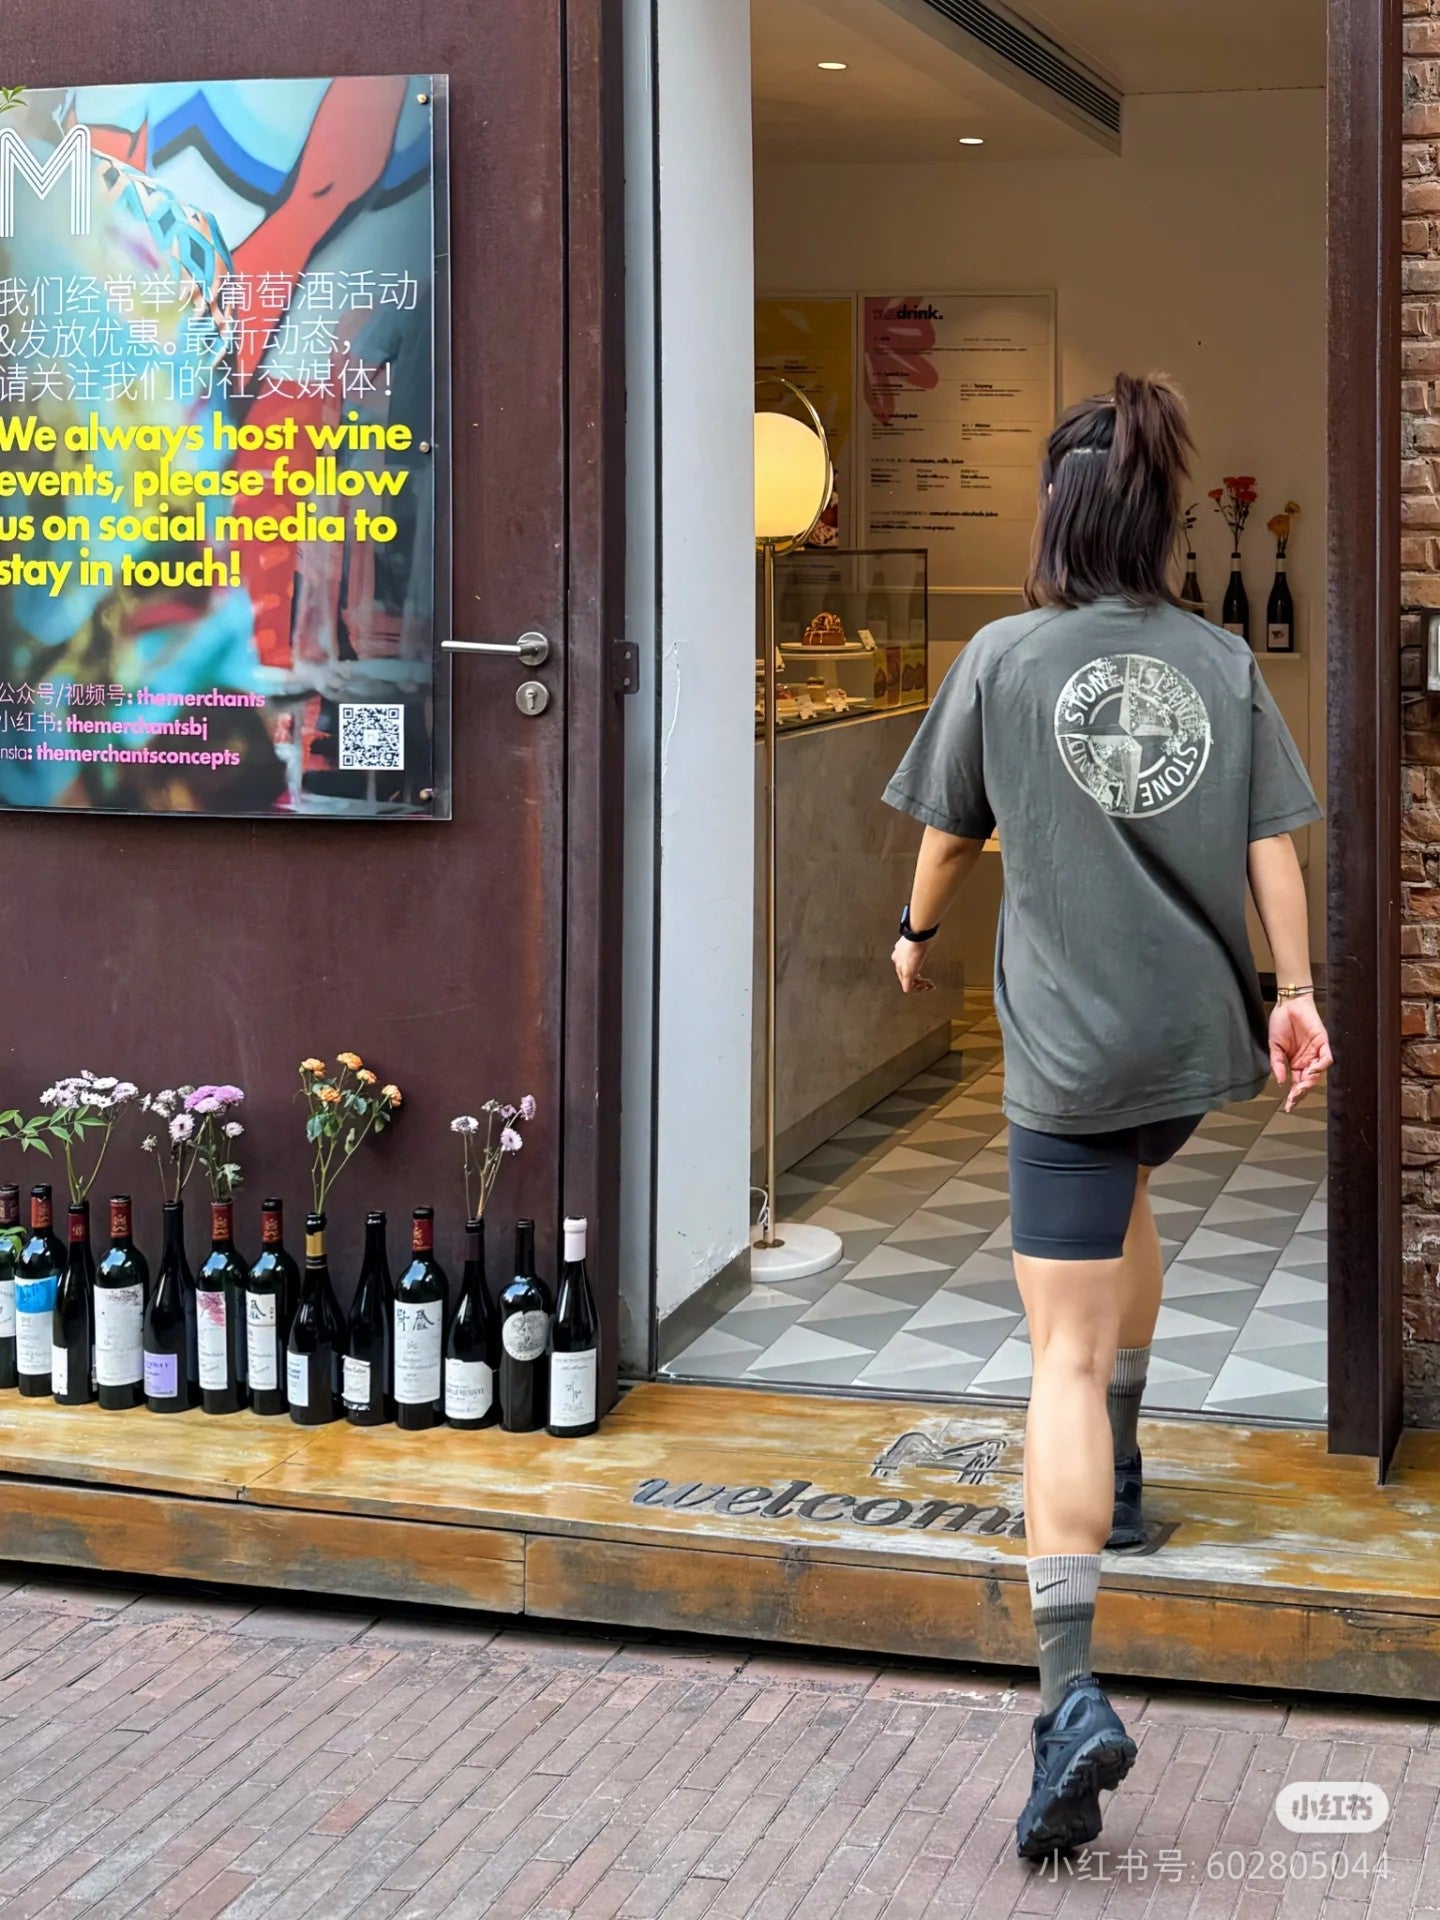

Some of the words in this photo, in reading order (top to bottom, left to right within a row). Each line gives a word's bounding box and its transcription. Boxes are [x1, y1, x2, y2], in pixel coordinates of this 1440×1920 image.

[0, 270, 418, 316] 我们经常举办葡萄酒活动
[896, 304, 944, 321] drink.
[0, 415, 57, 452] We
[64, 411, 203, 461] always
[213, 411, 299, 451] host
[305, 411, 412, 451] wine
[0, 464, 124, 503] events,
[134, 457, 264, 507] please
[272, 456, 408, 497] follow
[0, 514, 35, 541] us
[42, 514, 90, 541] on
[98, 501, 205, 543] social
[215, 502, 346, 543] media
[354, 508, 397, 543] to
[0, 552, 73, 597] stay
[80, 547, 113, 587] in
[121, 547, 241, 588] touch!
[136, 686, 266, 708] themerchants
[65, 713, 208, 741] themerchantsbj
[36, 741, 240, 770] themerchantsconcepts
[1138, 746, 1199, 807] STONE
[632, 1477, 1027, 1539] welcom
